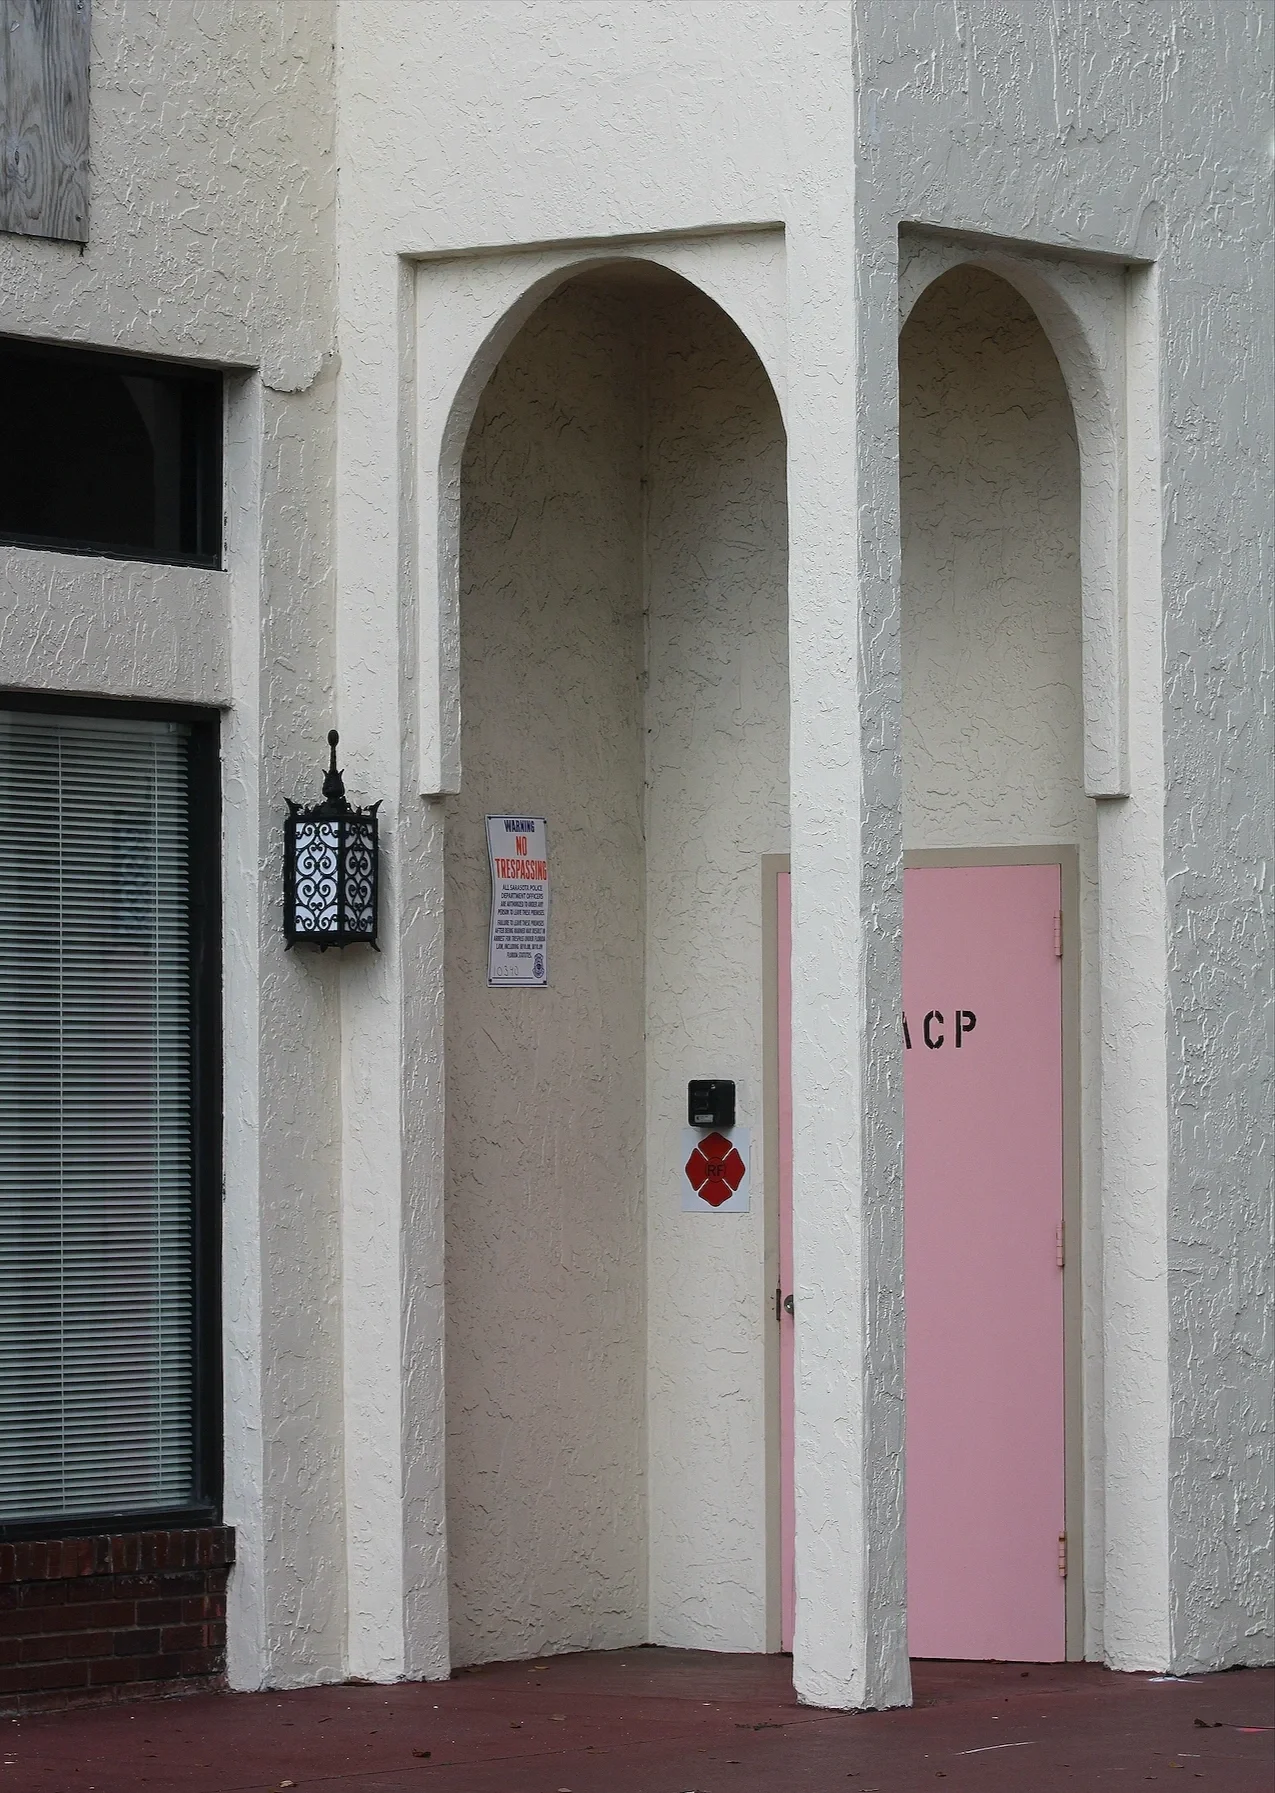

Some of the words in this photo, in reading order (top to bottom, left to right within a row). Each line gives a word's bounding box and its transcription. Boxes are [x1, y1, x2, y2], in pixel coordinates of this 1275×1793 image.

[504, 820, 534, 832] WARNING
[516, 836, 527, 856] NO
[495, 859, 546, 880] TRESPASSING
[707, 1164, 724, 1176] RF
